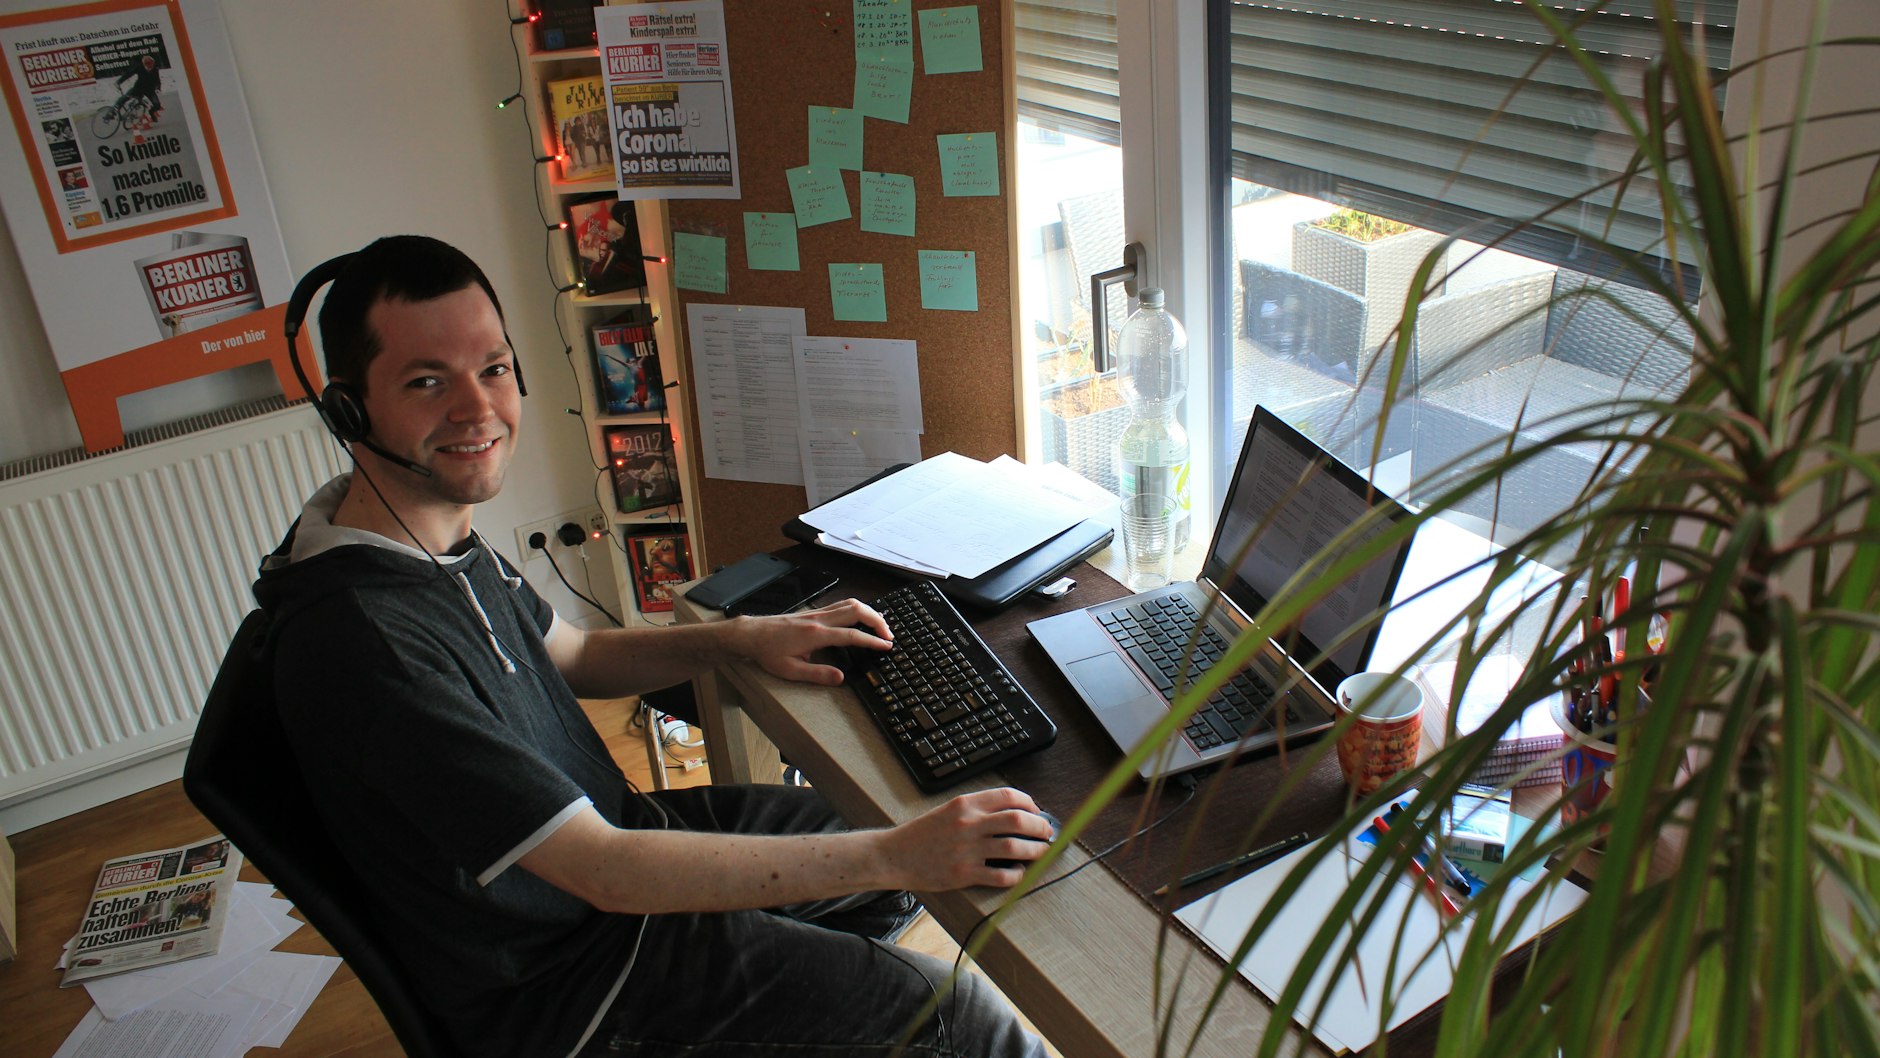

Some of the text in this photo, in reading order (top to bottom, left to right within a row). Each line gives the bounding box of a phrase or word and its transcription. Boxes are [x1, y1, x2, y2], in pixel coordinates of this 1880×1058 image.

[649, 12, 696, 26] Rätsel extra!
[15, 22, 160, 51] Frist läuft aus: Datschen in Gefahr
[630, 24, 697, 39] Kinderspaß extra!
[90, 43, 116, 55] Alkohol
[608, 46, 644, 57] BERLINER
[666, 50, 697, 59] Hier finden
[22, 49, 87, 71] BERLINER
[609, 55, 661, 73] KURIER
[27, 63, 90, 87] KURIER 25
[667, 68, 681, 76] Hilfe
[681, 68, 690, 76] für
[705, 67, 723, 77] Alltag
[566, 86, 605, 105] BLING
[569, 82, 593, 96] THE
[577, 95, 606, 110] RIN
[614, 102, 702, 130] Ich habe
[97, 144, 124, 168] So
[123, 133, 182, 162] knülle
[618, 130, 698, 155] Corona,
[621, 158, 640, 175] so
[640, 156, 660, 173] ist
[660, 158, 678, 173] es
[678, 154, 731, 173] wirklich
[111, 162, 184, 192] machen
[101, 196, 131, 221] 1,6
[131, 180, 207, 214] Promille
[148, 250, 246, 288] BERLINER
[156, 276, 231, 310] KURIER
[200, 329, 267, 355] Der von hier
[598, 328, 620, 347] BILLY
[633, 340, 655, 358] LIVE
[622, 431, 663, 458] 2012
[101, 867, 157, 887] KURIER
[104, 865, 143, 876] BERLINER
[88, 880, 216, 918] Echte Berliner
[77, 913, 184, 950] zusammen!
[82, 909, 140, 934] halten
